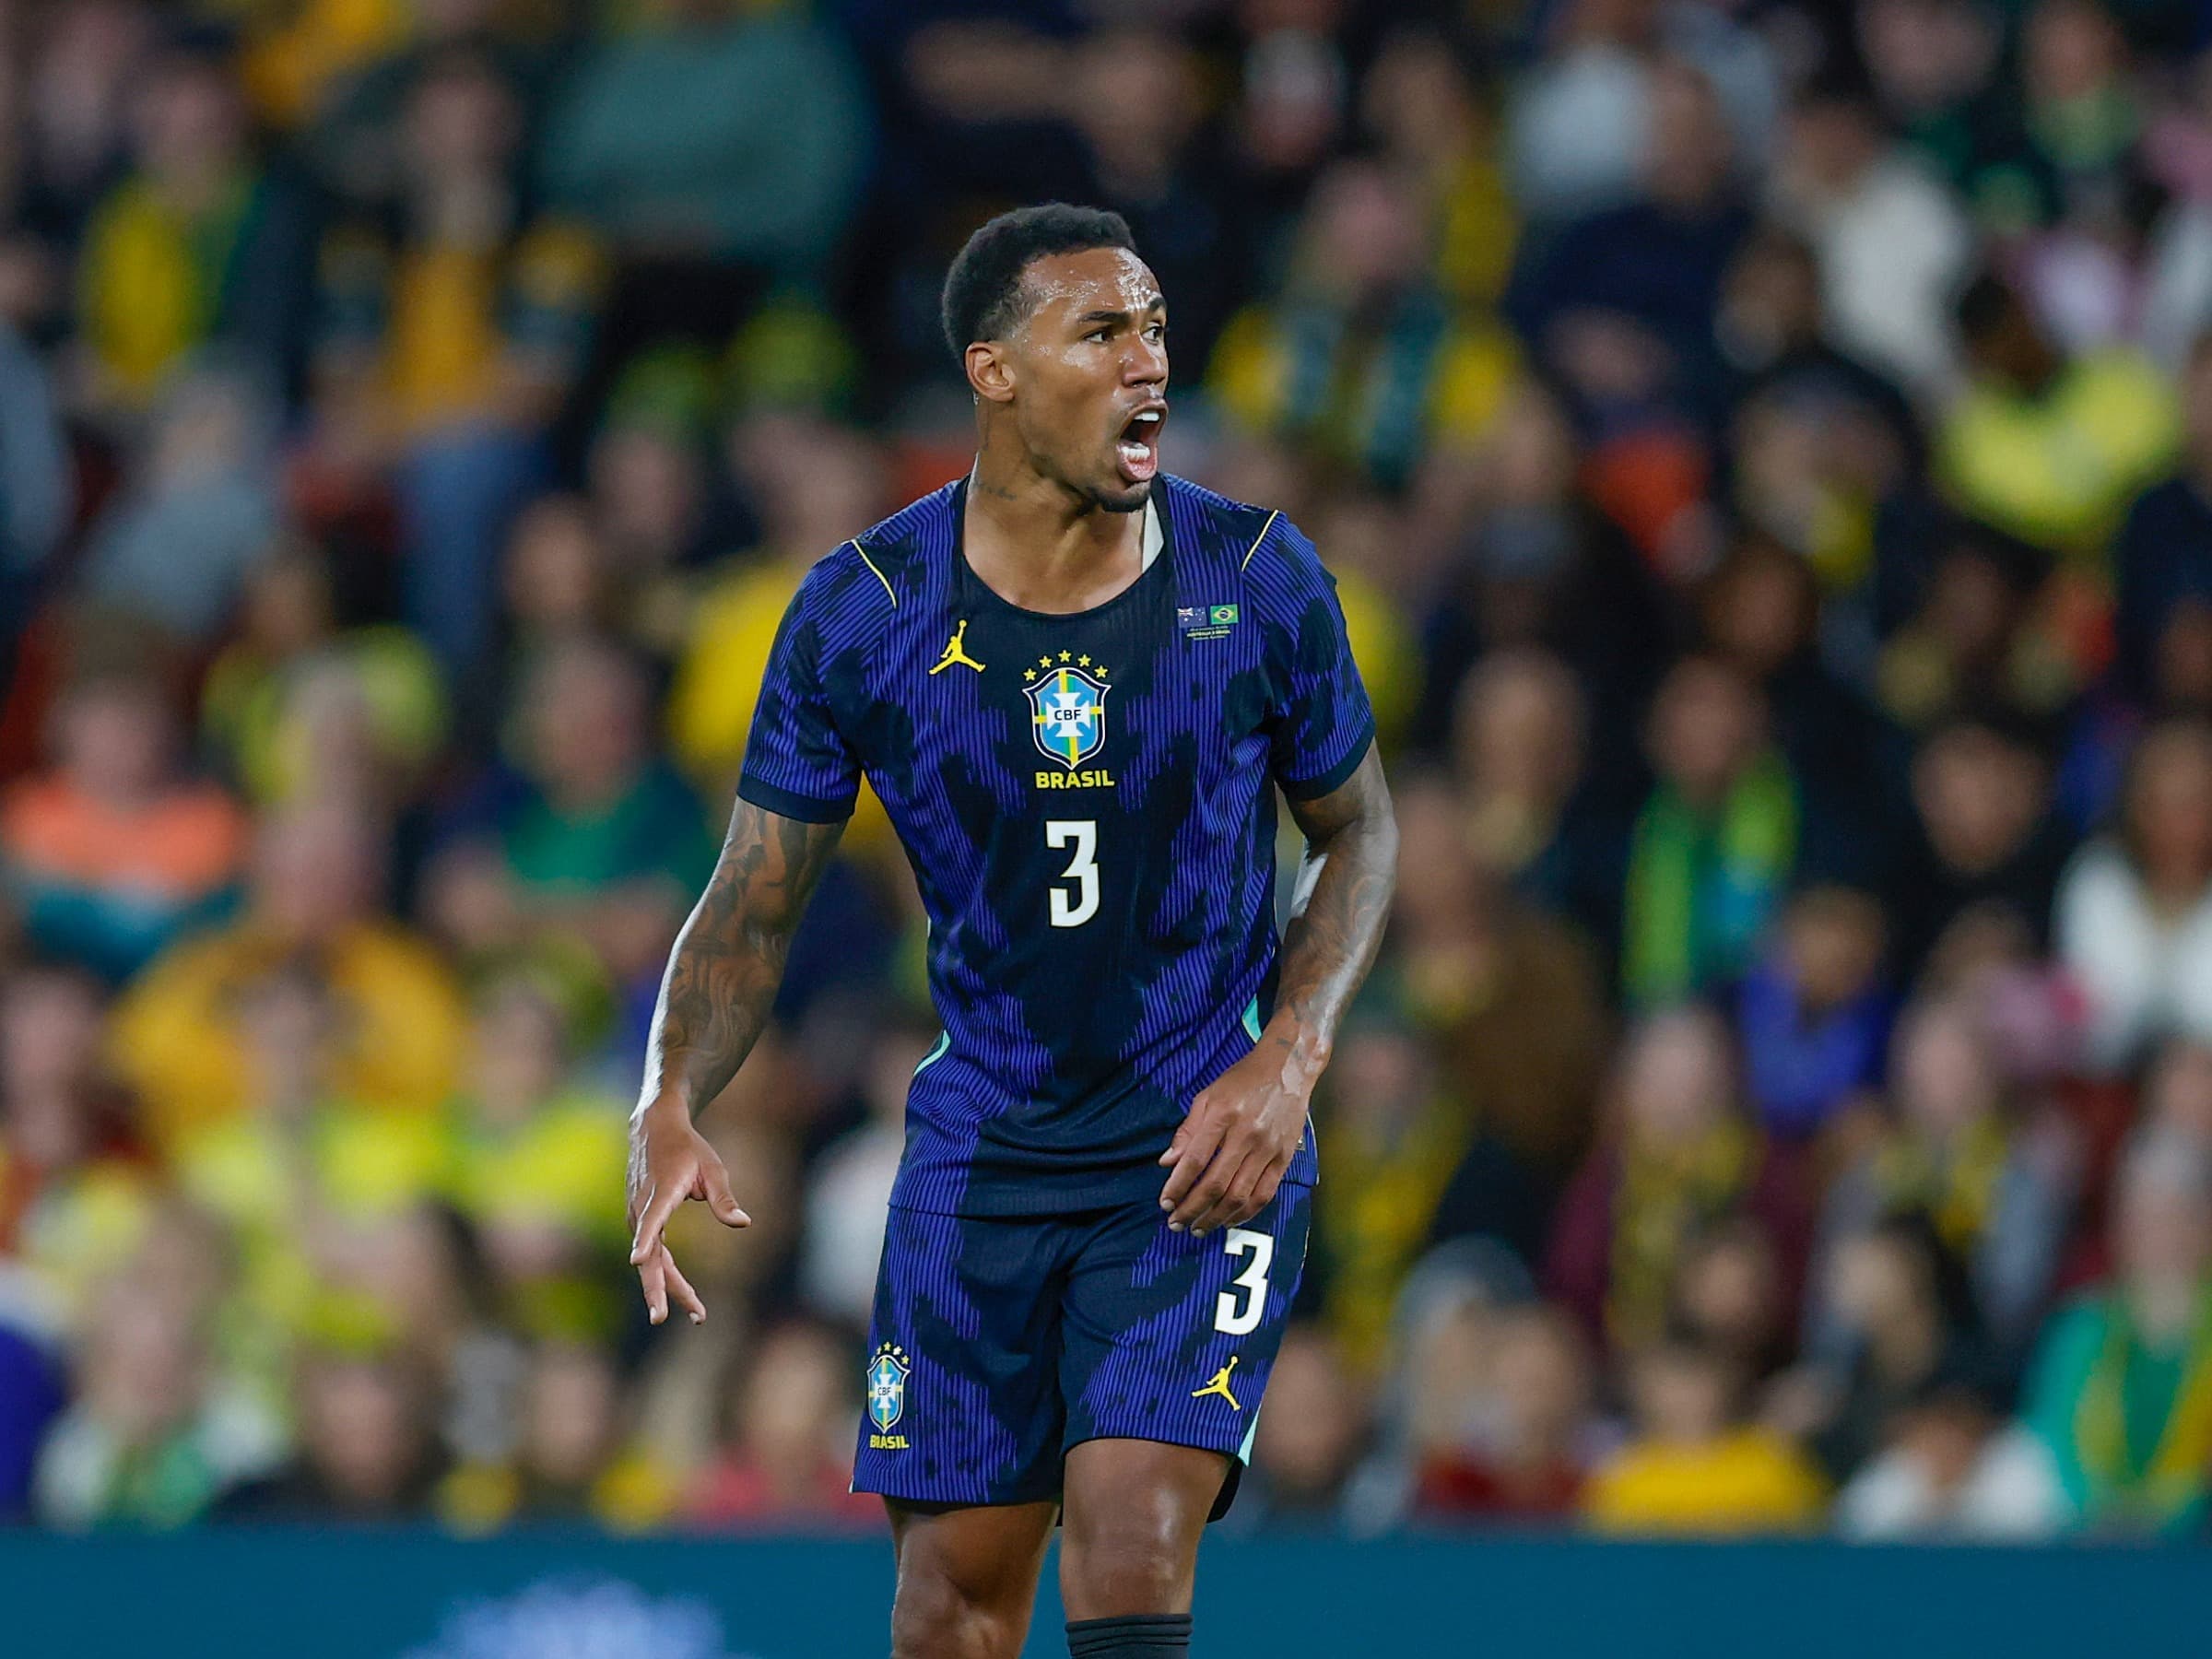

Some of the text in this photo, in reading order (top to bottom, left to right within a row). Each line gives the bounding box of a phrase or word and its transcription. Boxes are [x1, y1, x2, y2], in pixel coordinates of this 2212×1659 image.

[1053, 709, 1082, 721] CBF
[1035, 770, 1115, 789] BRASIL
[1045, 820, 1100, 927] 3
[1214, 1228, 1274, 1335] 3
[877, 1386, 892, 1396] CBF
